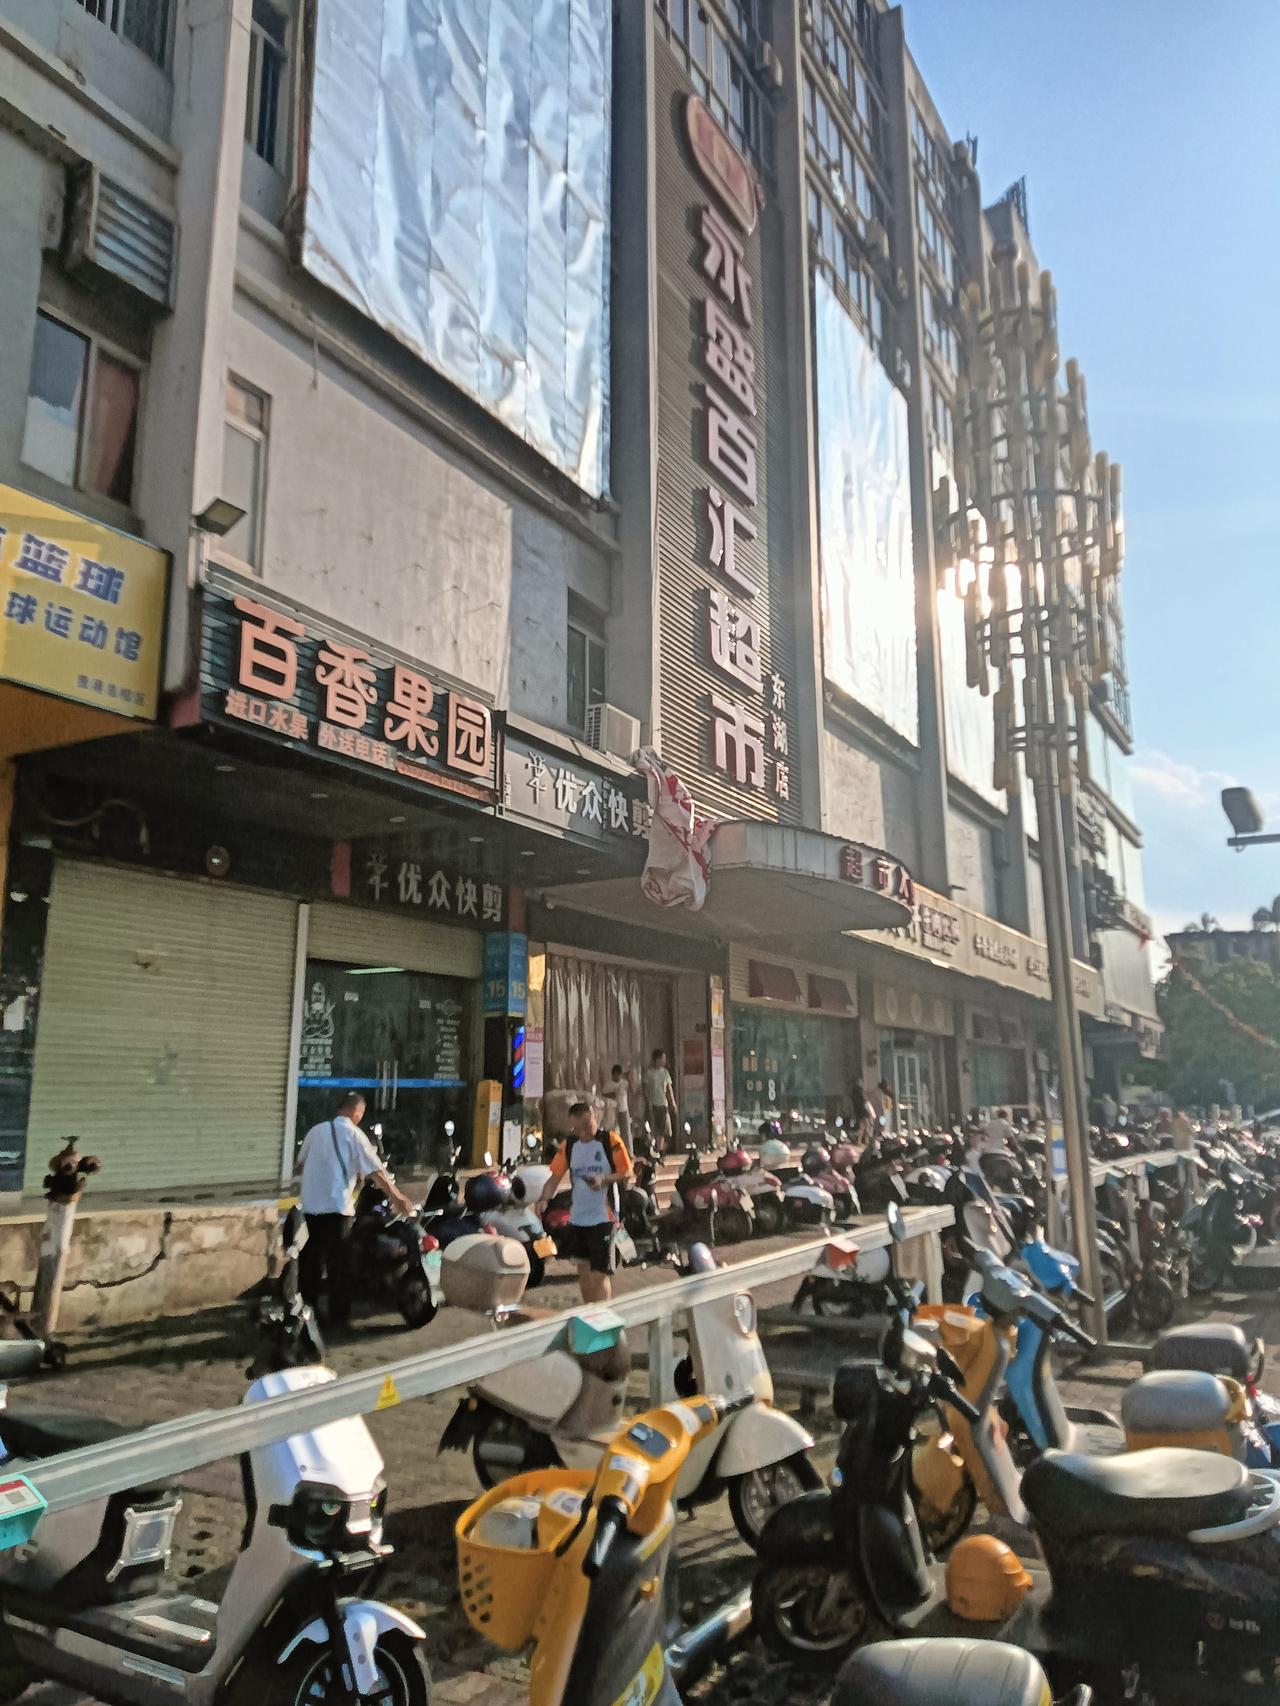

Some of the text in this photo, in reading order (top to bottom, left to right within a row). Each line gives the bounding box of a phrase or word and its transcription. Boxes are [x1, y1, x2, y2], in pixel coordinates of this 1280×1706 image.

[0, 526, 126, 605] 篮球
[233, 596, 493, 777] 百香果园
